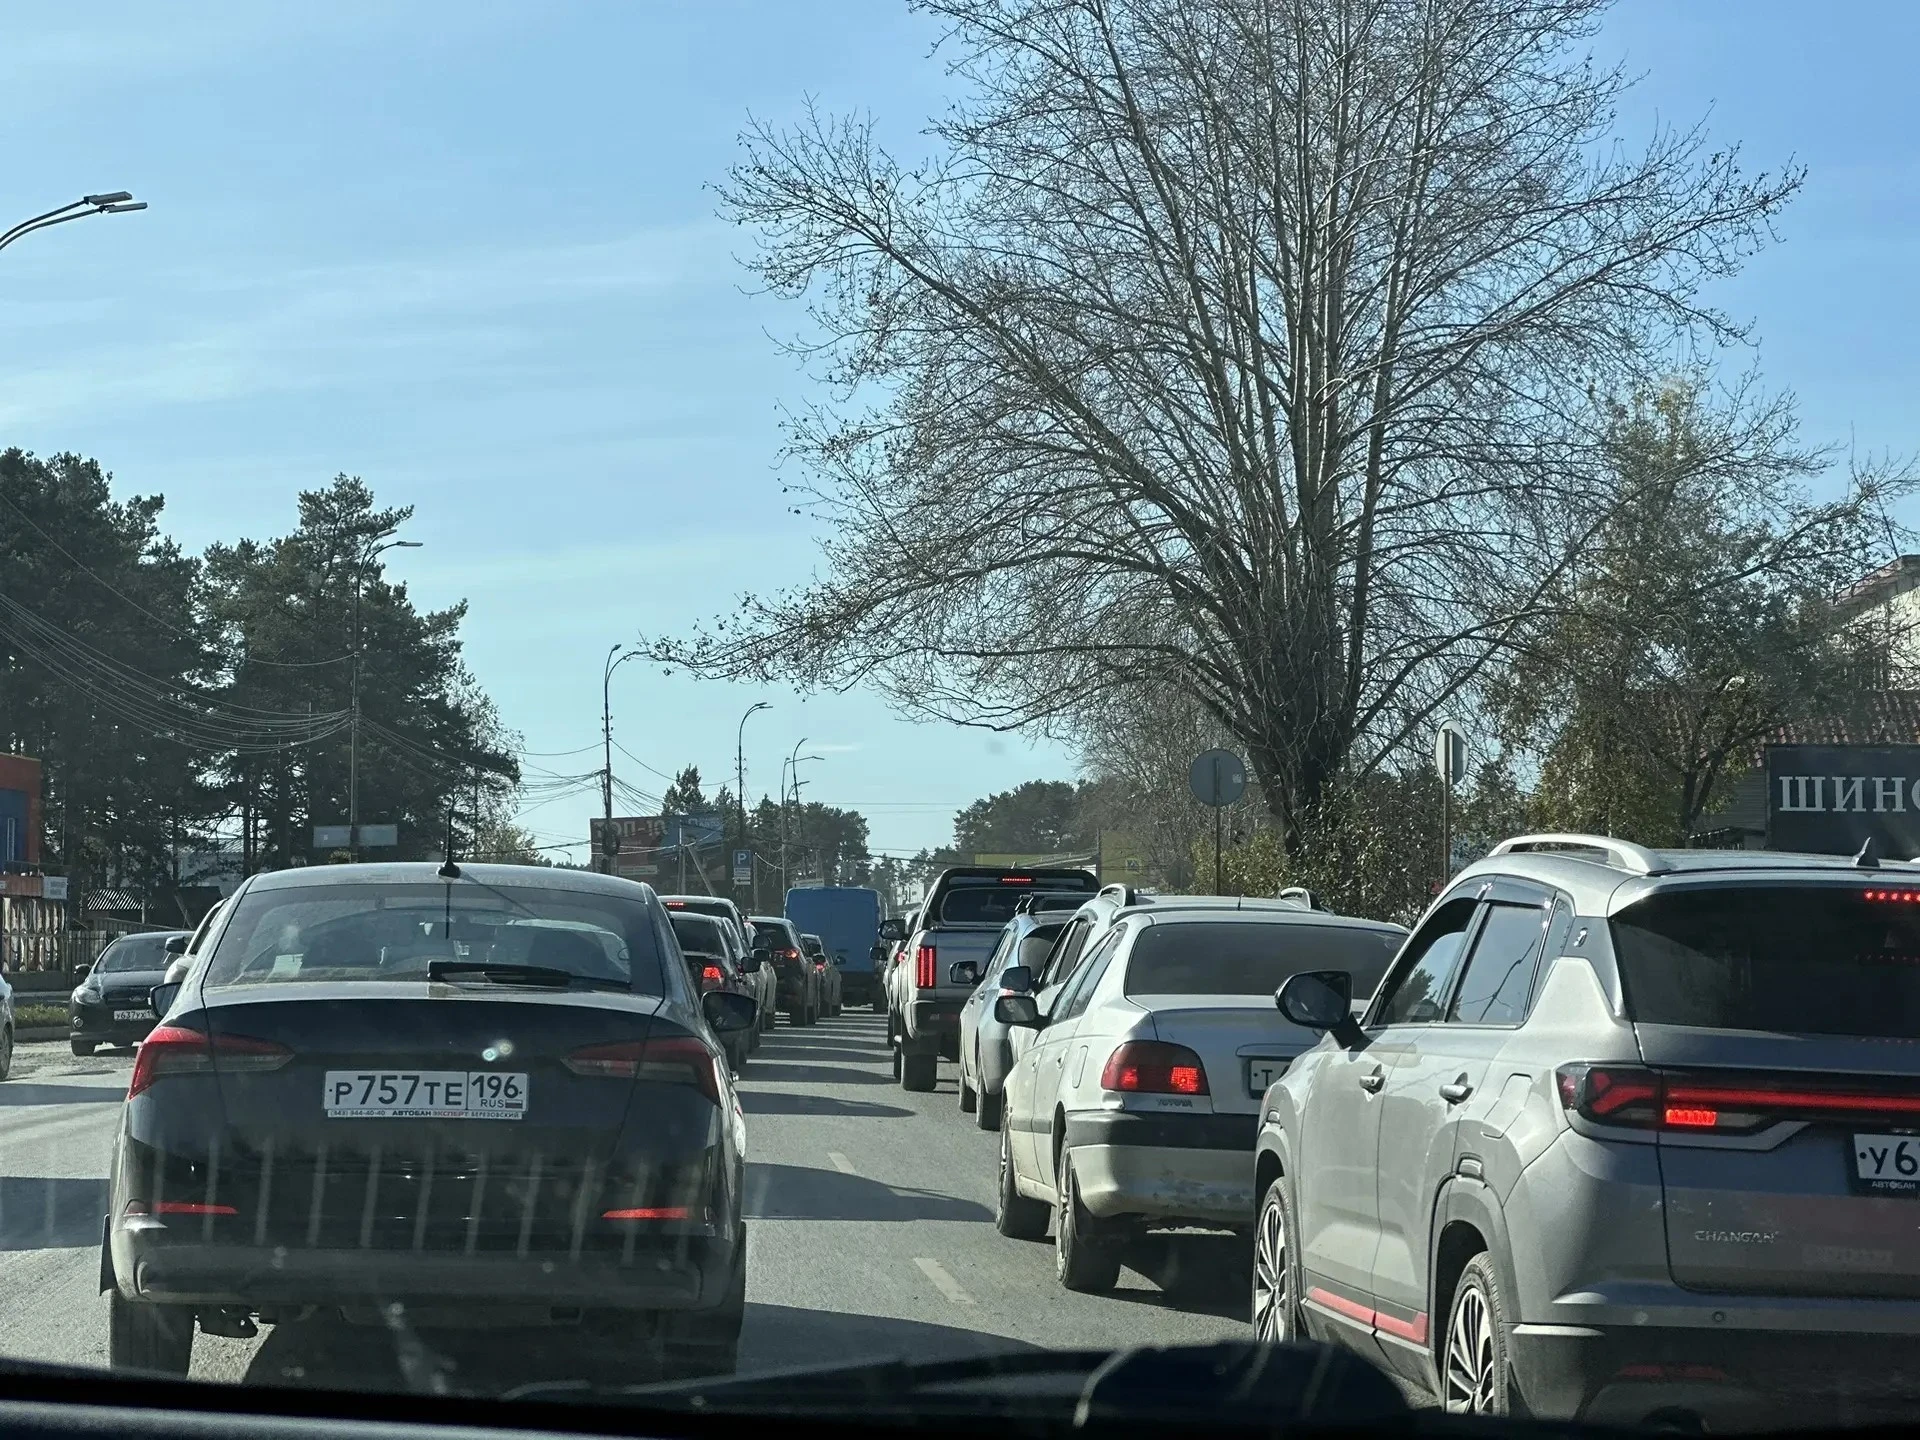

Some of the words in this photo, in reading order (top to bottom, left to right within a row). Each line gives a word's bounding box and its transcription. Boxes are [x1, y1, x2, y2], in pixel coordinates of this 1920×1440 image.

[1779, 776, 1920, 812] ШИН
[737, 853, 747, 865] P
[335, 1075, 463, 1106] Р757ТЕ
[471, 1075, 519, 1099] 196
[480, 1098, 505, 1108] RUS
[1869, 1141, 1920, 1176] У6
[1694, 1230, 1774, 1244] CHANGAN
